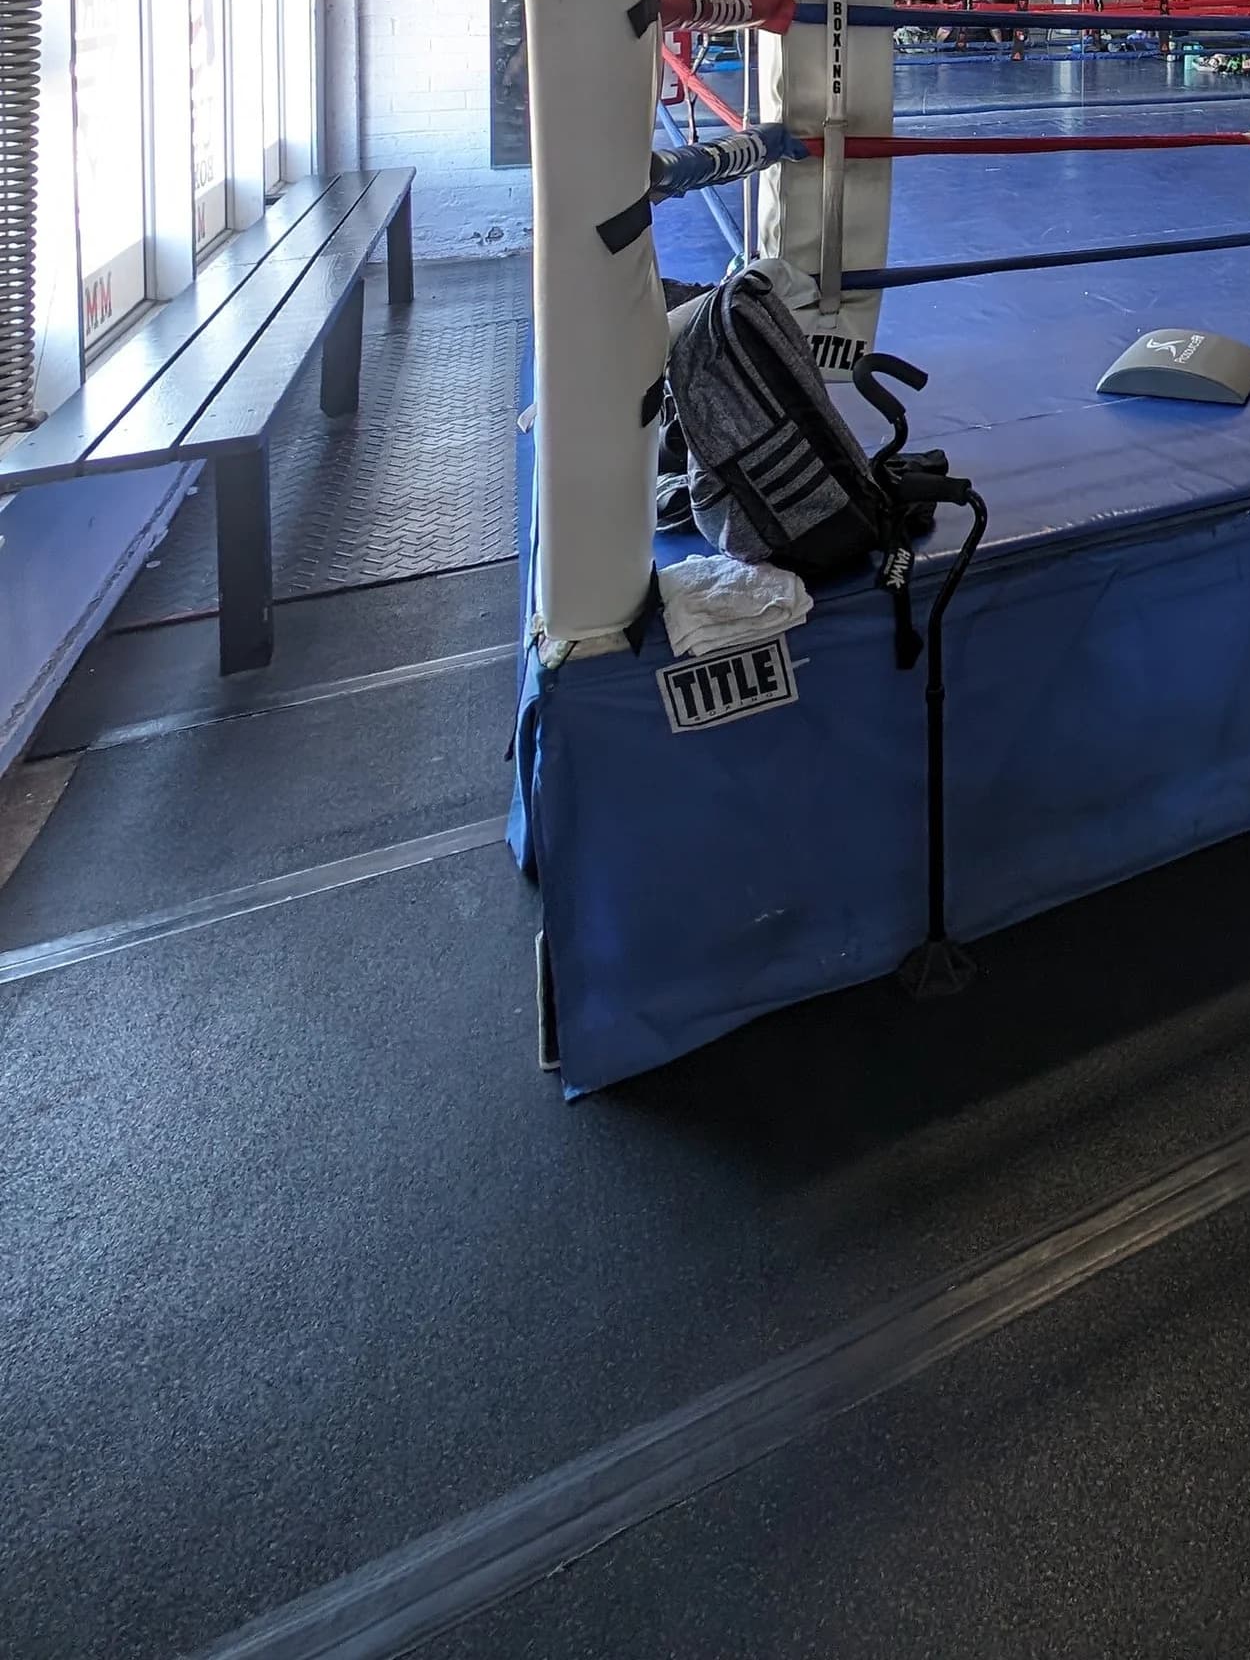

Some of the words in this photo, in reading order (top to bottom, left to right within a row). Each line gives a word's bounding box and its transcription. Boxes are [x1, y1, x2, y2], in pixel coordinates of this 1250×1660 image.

[832, 1, 842, 94] BOXING
[811, 334, 867, 371] TITLE
[671, 648, 778, 719] TITLE
